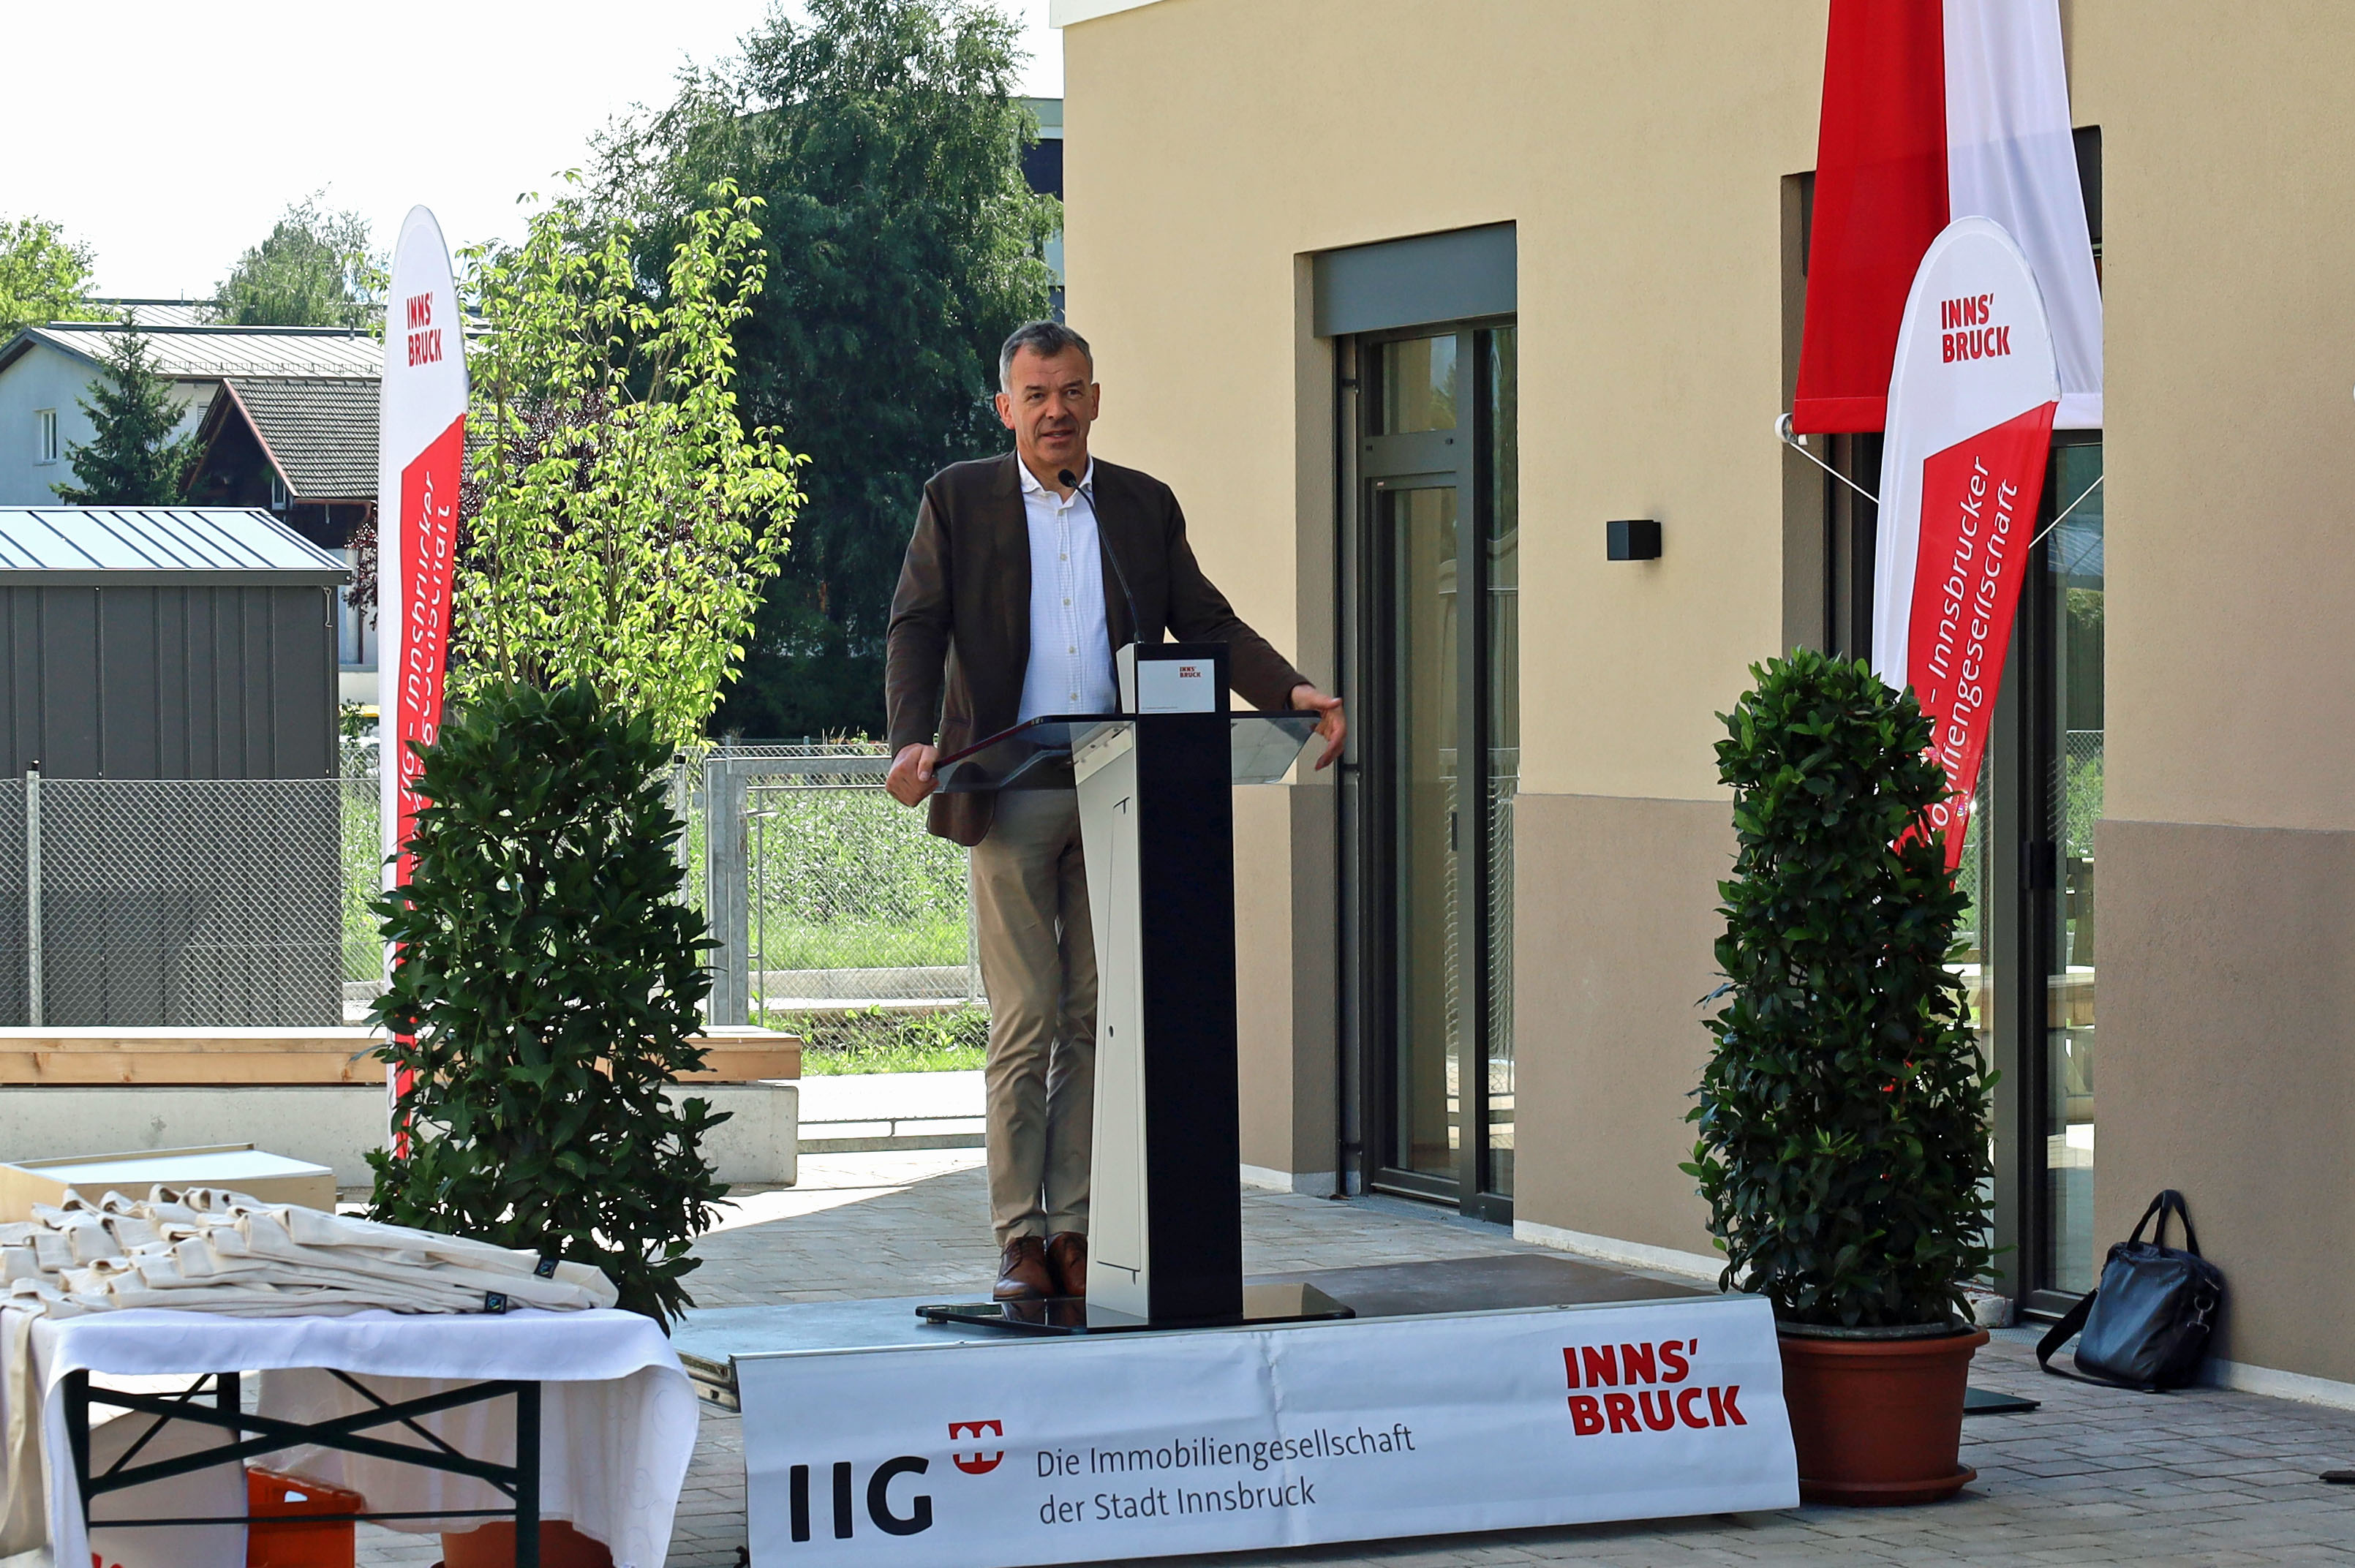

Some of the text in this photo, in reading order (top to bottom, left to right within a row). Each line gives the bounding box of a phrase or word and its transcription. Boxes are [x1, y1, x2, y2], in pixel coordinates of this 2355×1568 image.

[407, 291, 433, 330] INNS'
[1941, 293, 1994, 330] INNS'
[408, 328, 442, 367] BRUCK
[1942, 325, 2011, 363] BRUCK
[1928, 456, 1989, 679] Innsbrucker
[1564, 1338, 1697, 1389] INNS'
[1569, 1385, 1747, 1435] BRUCK
[1037, 1423, 1415, 1477] Die Immobiliengesellschaft
[790, 1455, 933, 1542] IIG
[1040, 1476, 1315, 1524] der Stadt Innsbruck
